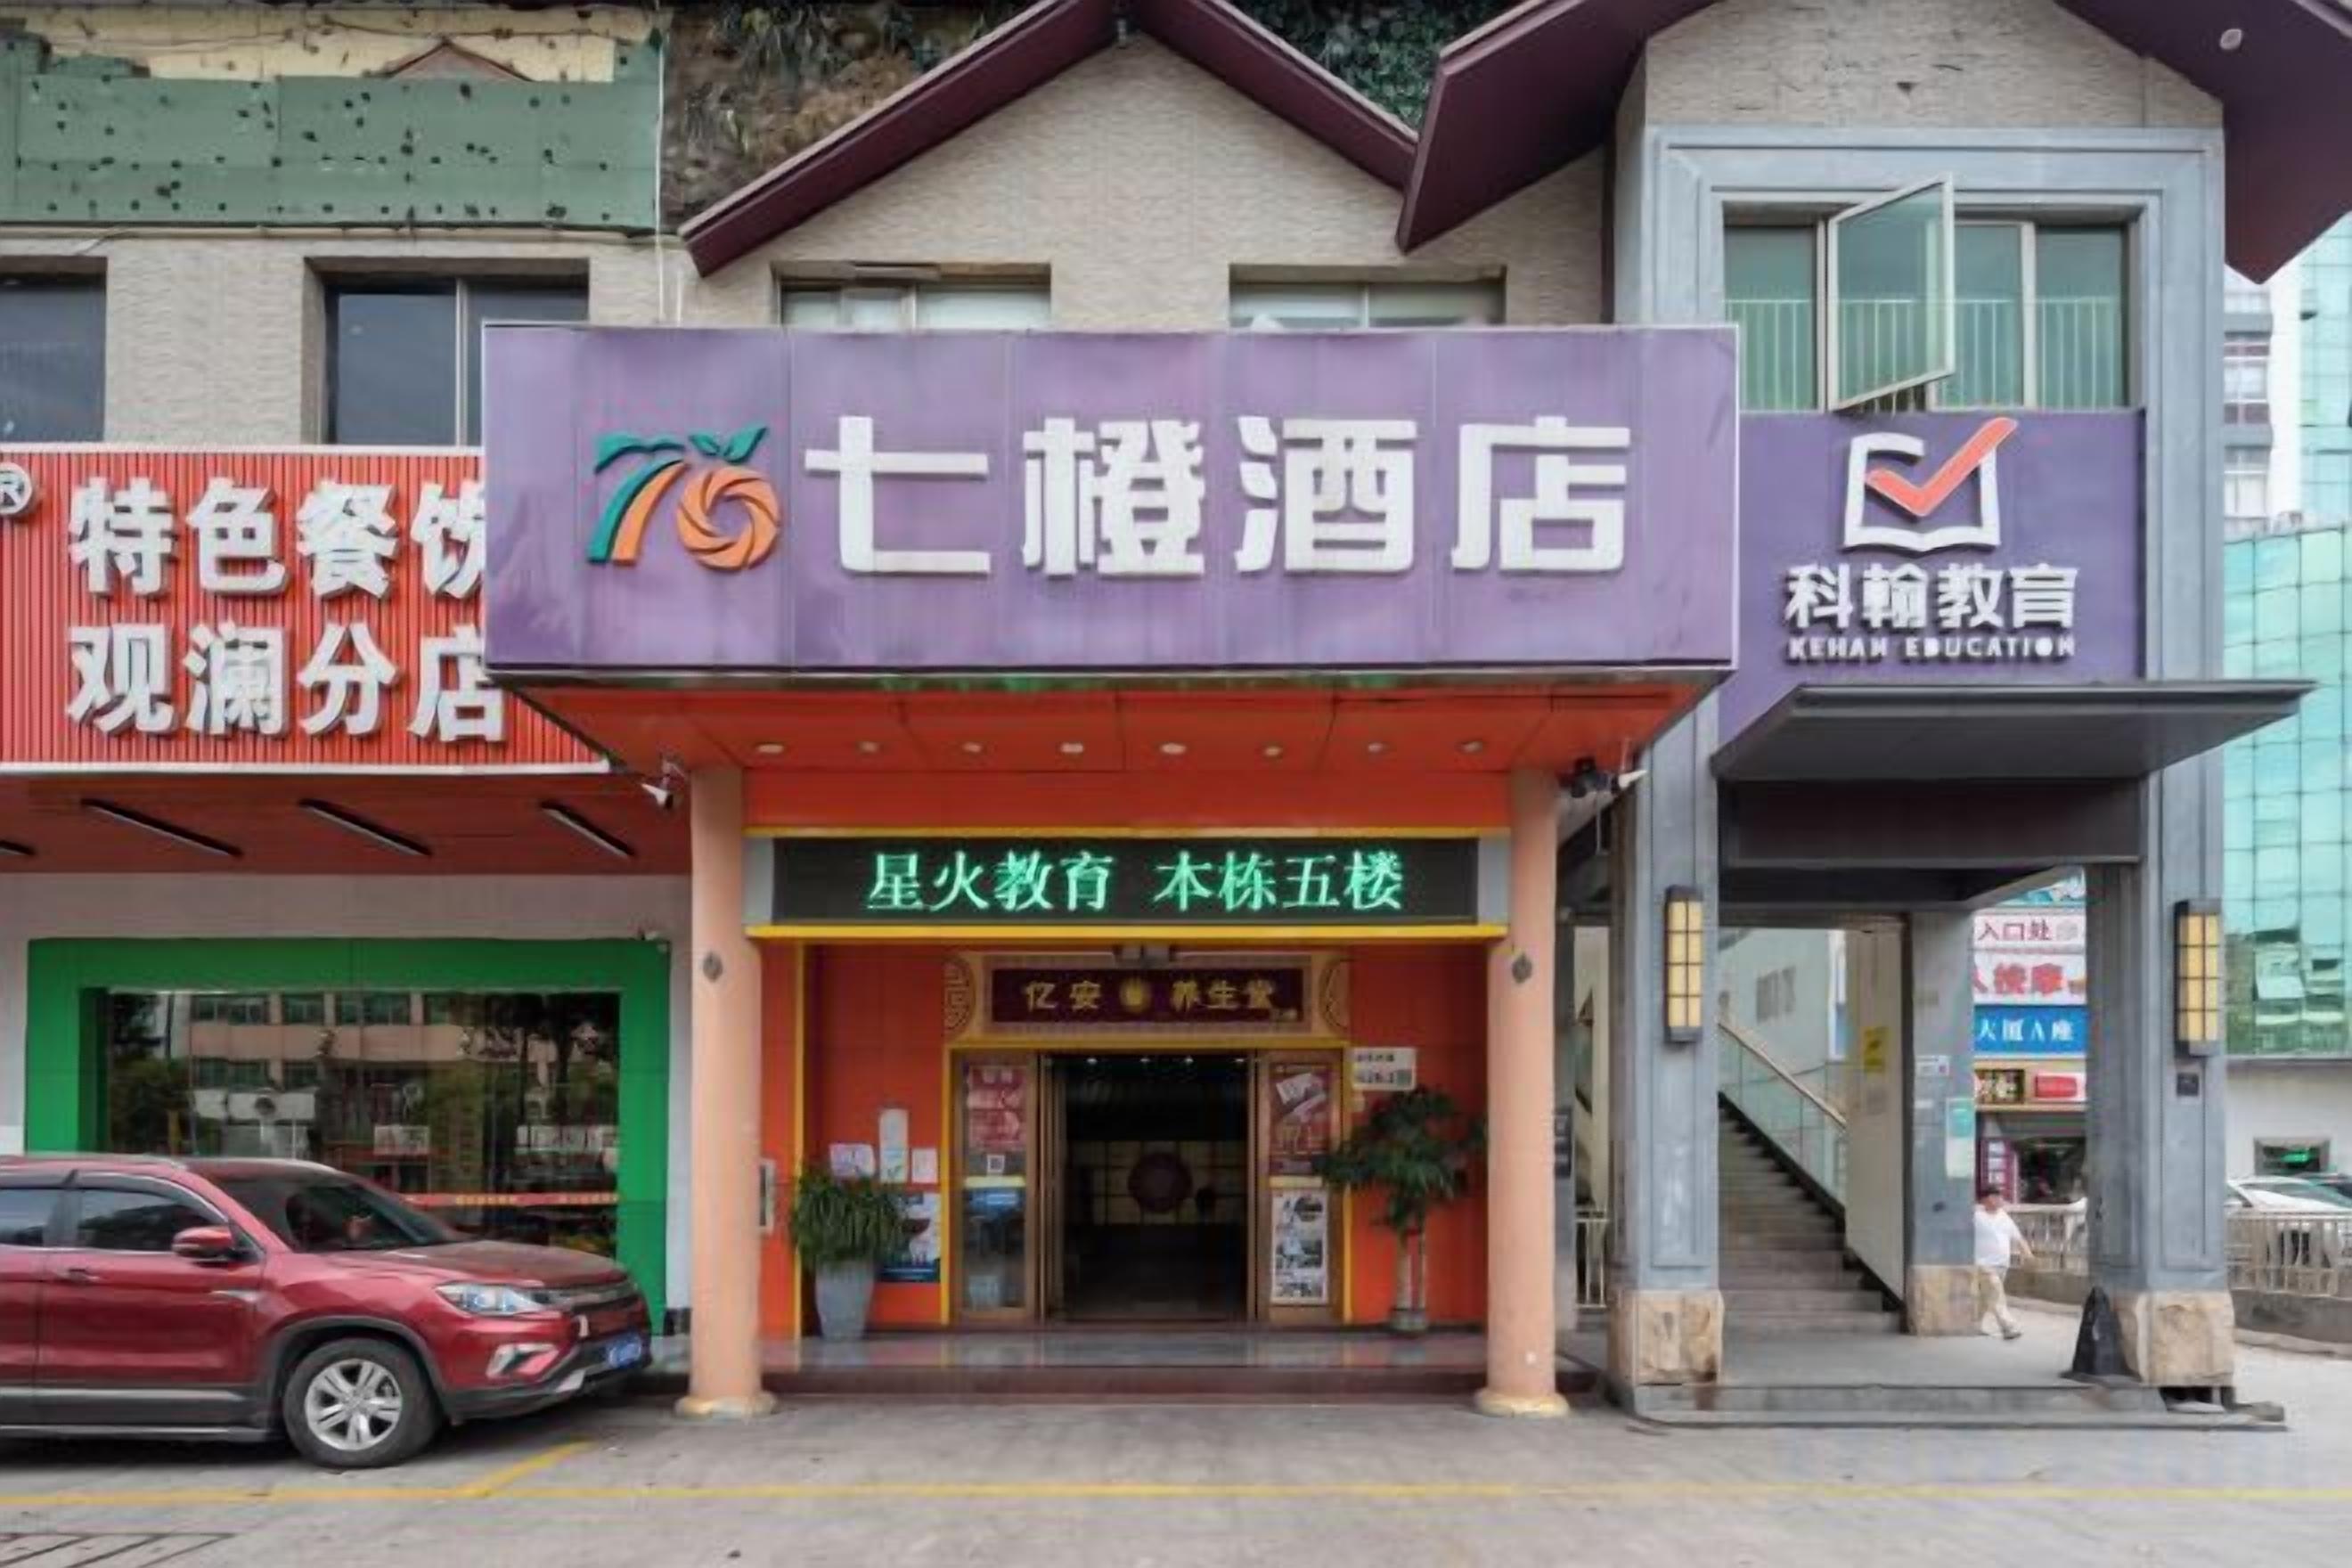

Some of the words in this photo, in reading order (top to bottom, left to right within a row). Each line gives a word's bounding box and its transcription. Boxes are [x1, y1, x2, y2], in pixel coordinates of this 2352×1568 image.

[804, 413, 1632, 577] 七橙酒店
[1784, 562, 2078, 629] 科翰教育
[67, 620, 504, 741] 观澜分店
[1906, 636, 2076, 658] EDUCATION
[867, 850, 1114, 912] 星火教育
[1153, 850, 1405, 912] 本栋五楼
